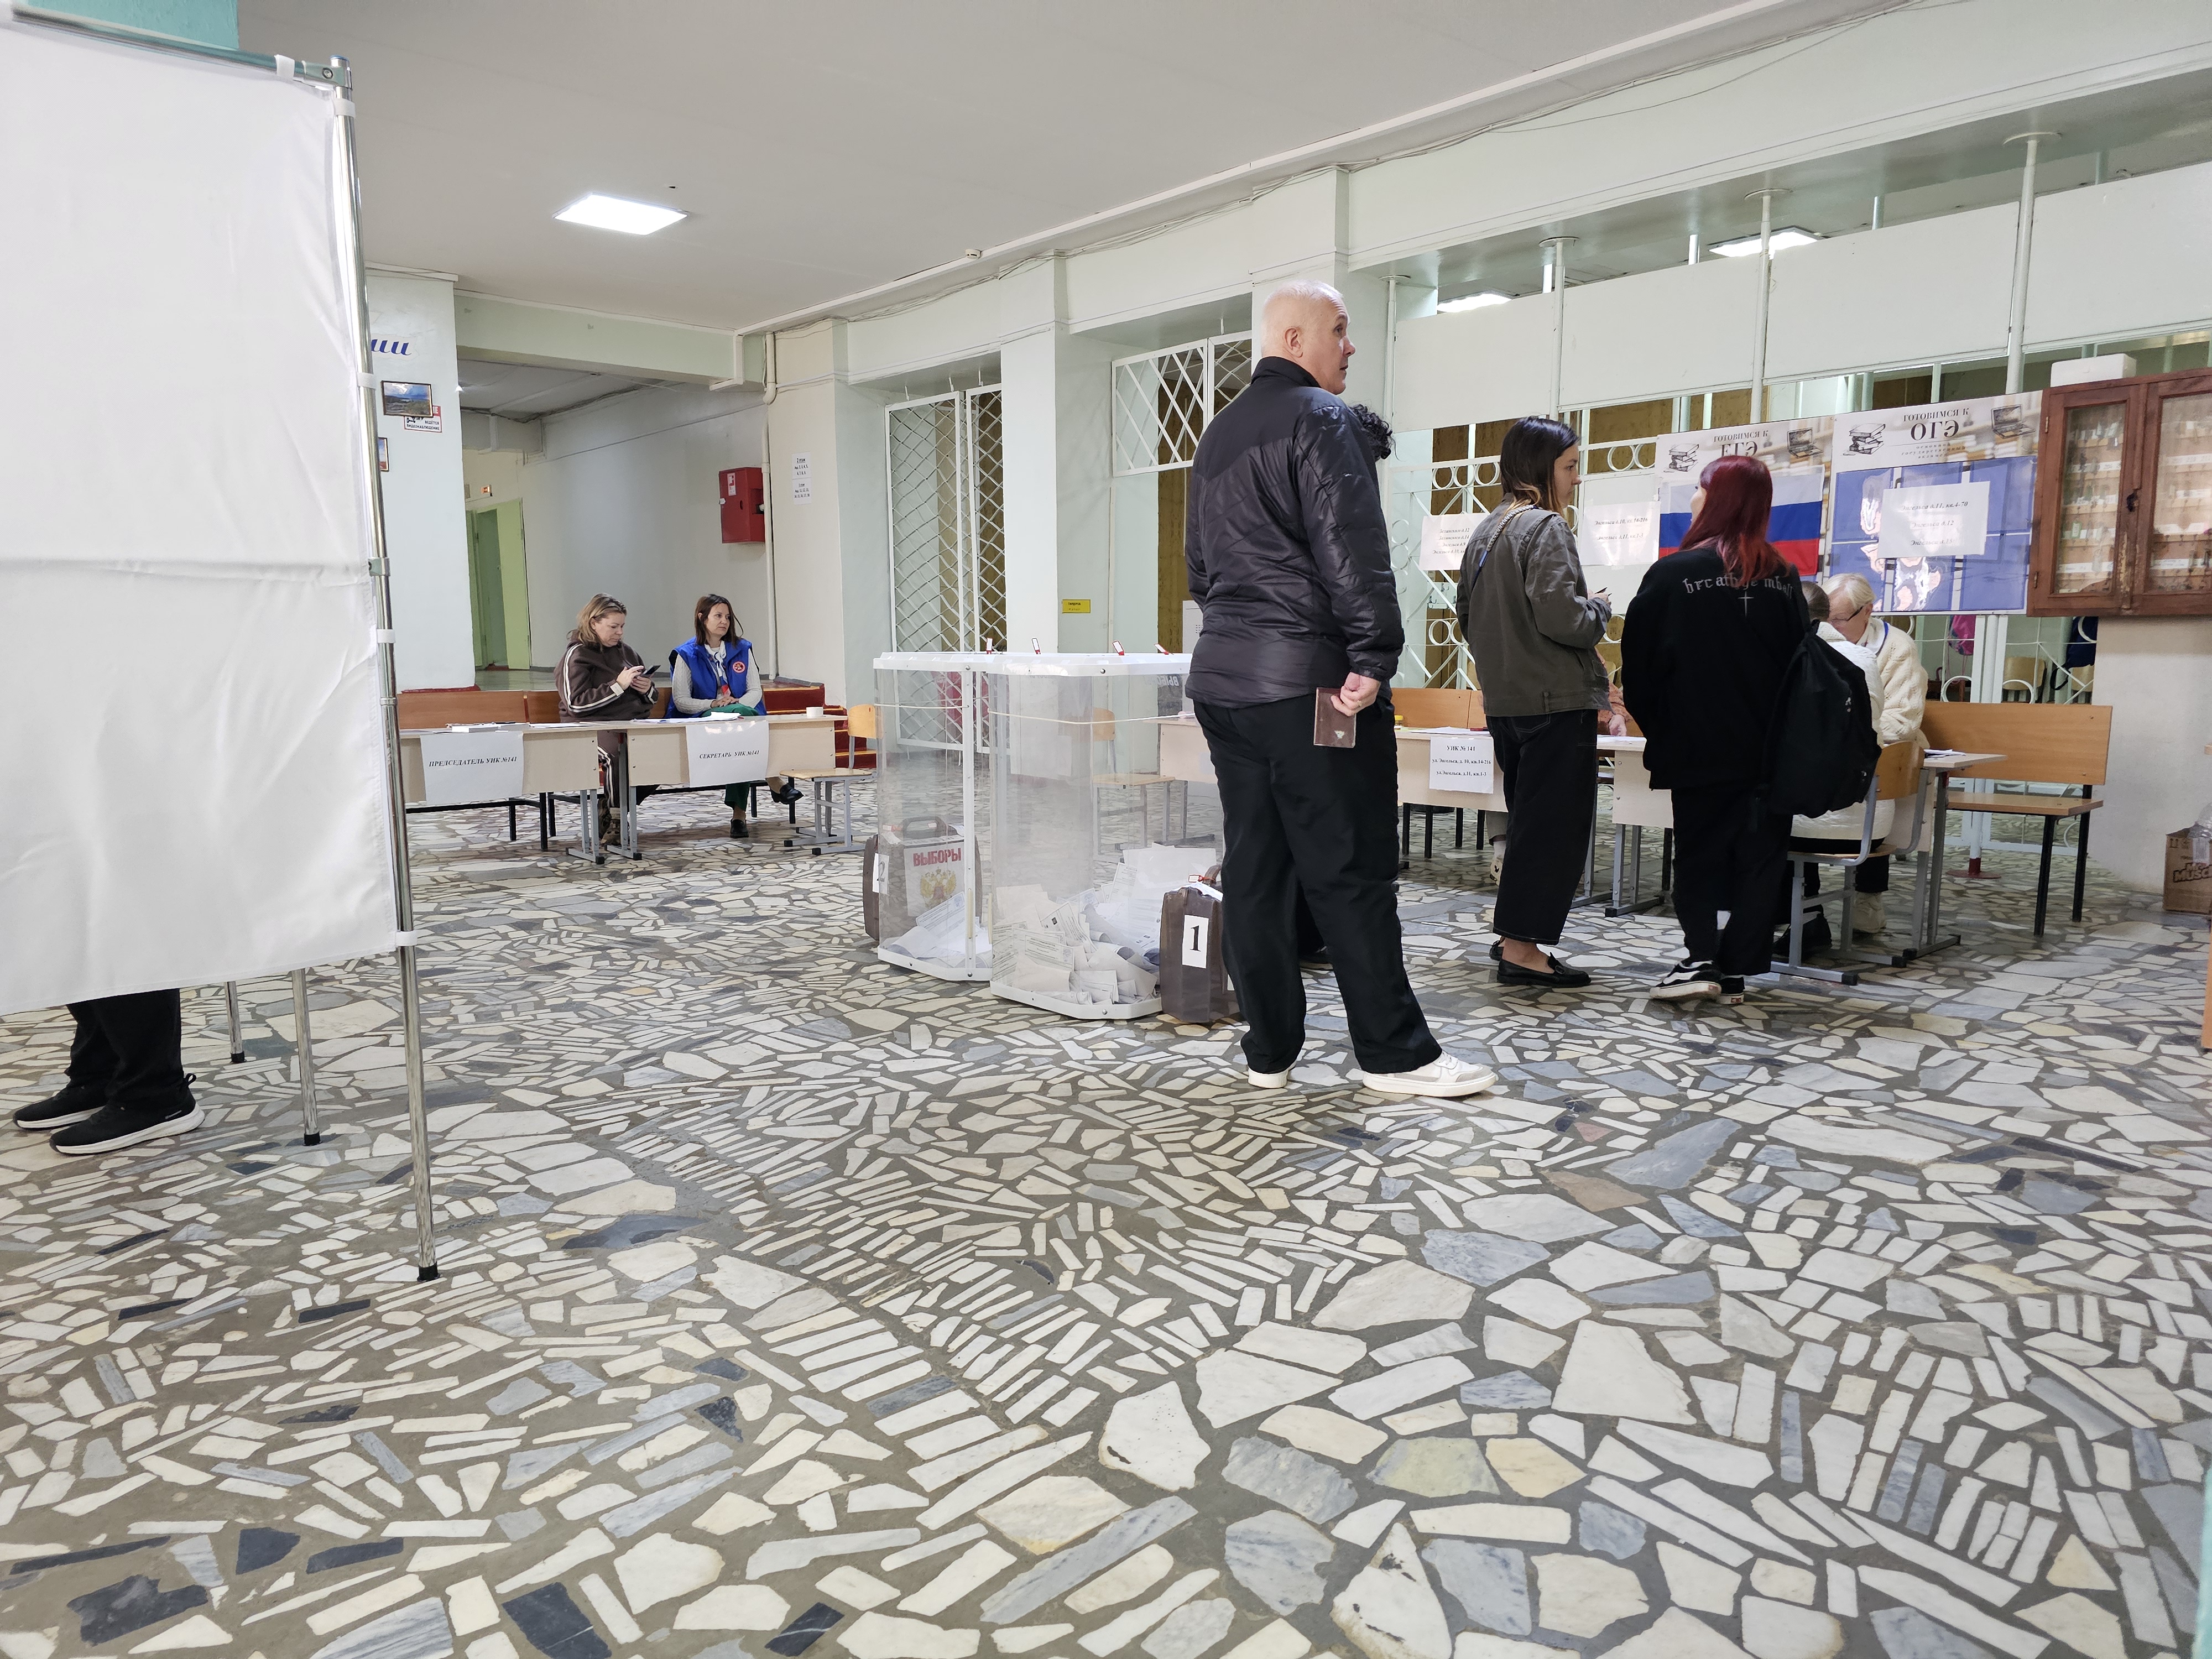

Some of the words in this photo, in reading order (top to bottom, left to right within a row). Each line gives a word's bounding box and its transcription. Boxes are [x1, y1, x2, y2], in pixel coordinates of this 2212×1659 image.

[1903, 409, 1959, 422] ГОТОВИМСЯ
[1714, 431, 1760, 442] ГОТОВИМСЯ
[1911, 420, 1959, 441] ОГЭ
[429, 758, 484, 767] ПРЕДСЕДАТЕЛЬ
[913, 847, 962, 867] ВЫБОРЫ
[876, 861, 885, 882] 2
[1190, 925, 1201, 952] 1
